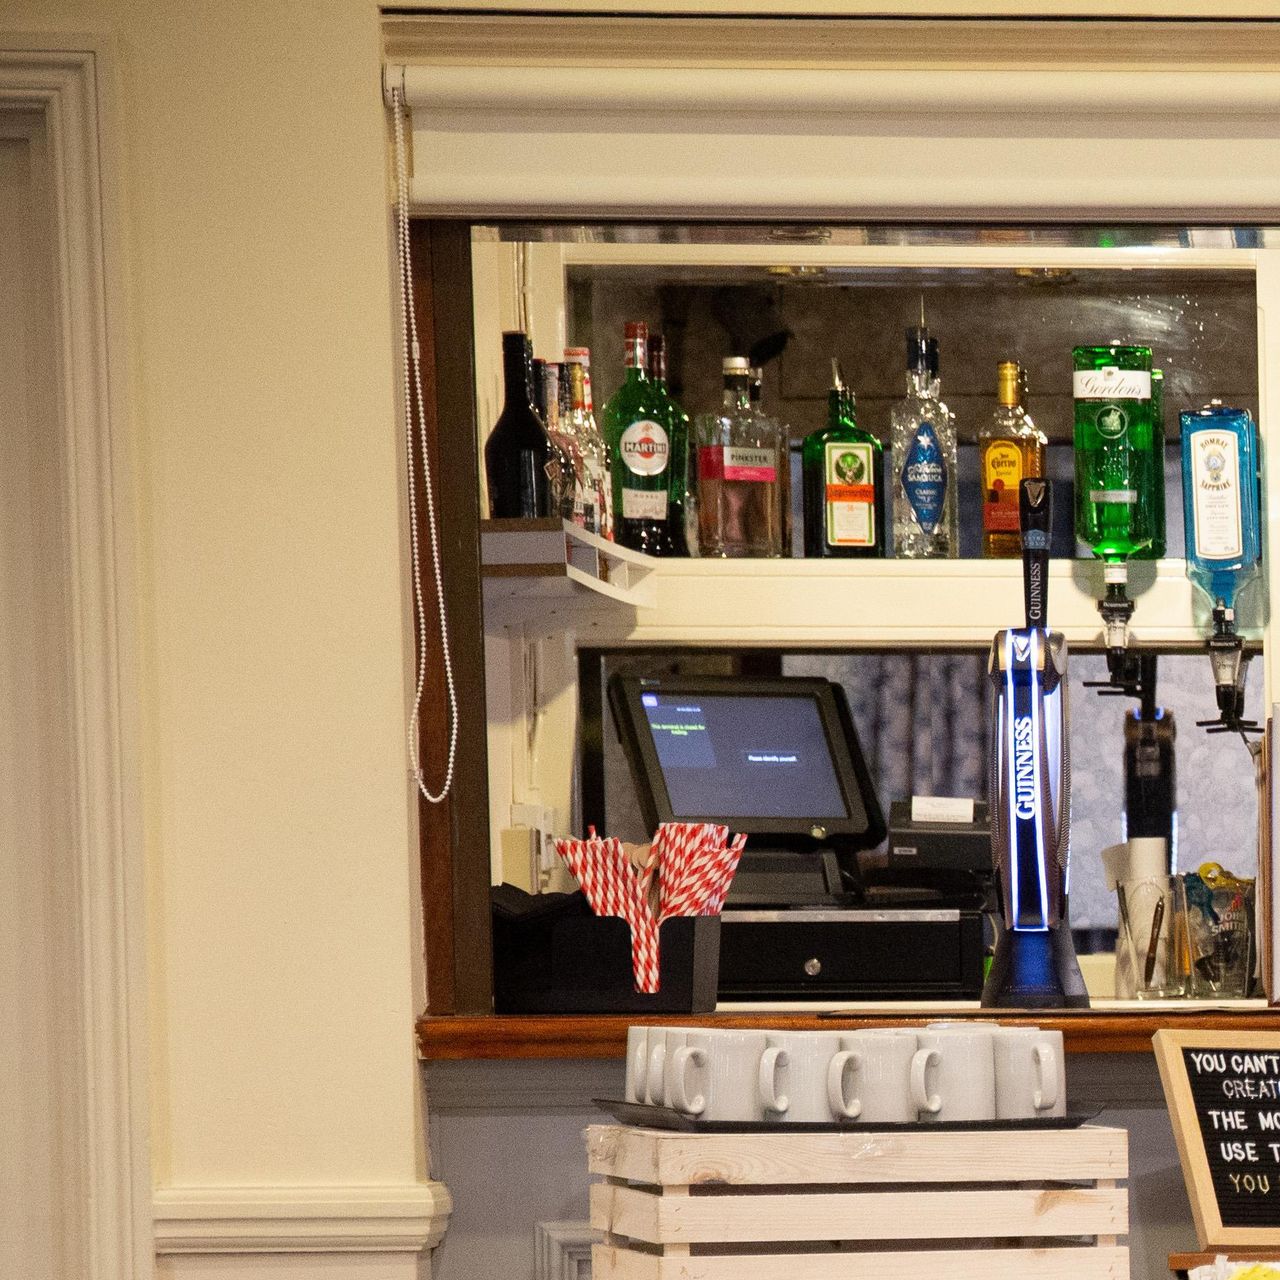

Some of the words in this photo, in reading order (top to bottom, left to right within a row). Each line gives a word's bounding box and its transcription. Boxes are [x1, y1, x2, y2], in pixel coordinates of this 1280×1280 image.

[1080, 375, 1143, 396] Gordon's
[624, 442, 667, 454] MARTINI
[1200, 480, 1232, 492] SAPPHIRE
[1028, 562, 1041, 620] GUINNESS
[1014, 715, 1036, 820] GUINNESS
[1190, 1053, 1226, 1074] YOU
[1231, 1054, 1280, 1075] CAN'T
[1207, 1110, 1249, 1131] THE
[1220, 1143, 1260, 1163] USE
[1229, 1174, 1270, 1195] YOU
